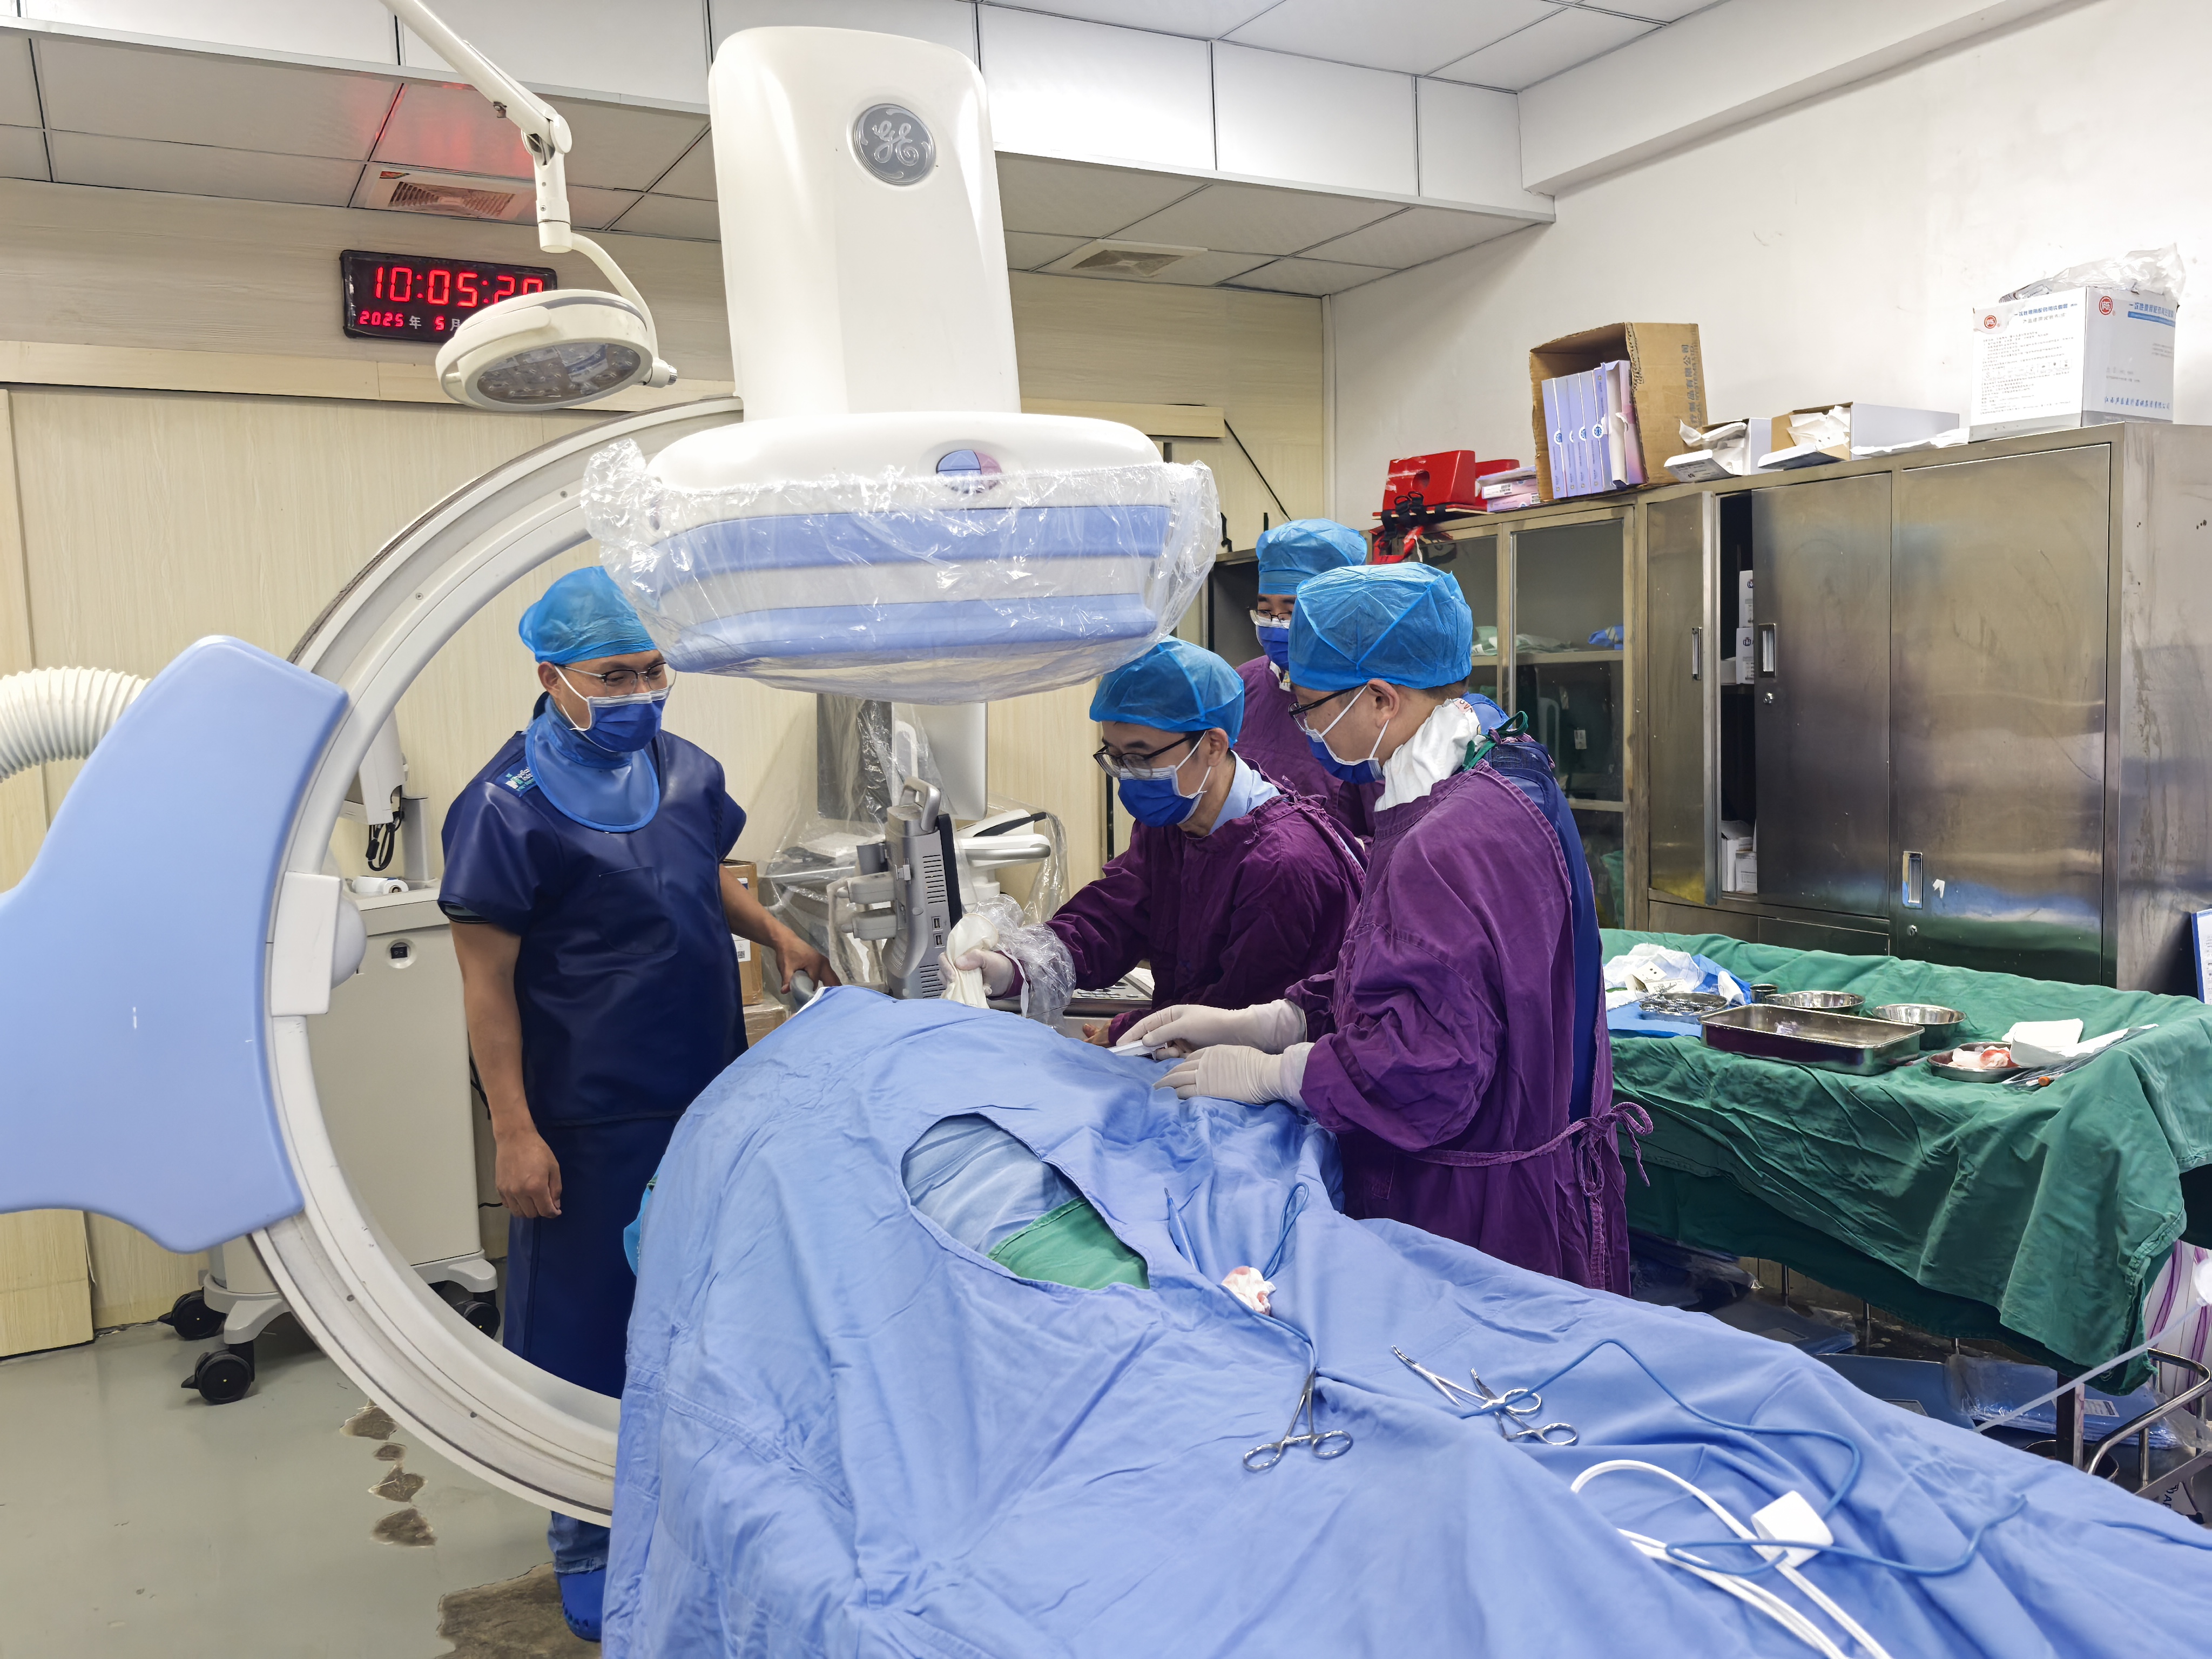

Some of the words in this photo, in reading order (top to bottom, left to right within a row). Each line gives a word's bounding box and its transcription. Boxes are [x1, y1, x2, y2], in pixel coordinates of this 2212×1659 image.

[359, 310, 404, 327] 2025
[409, 315, 422, 329] 年
[434, 316, 445, 331] 5
